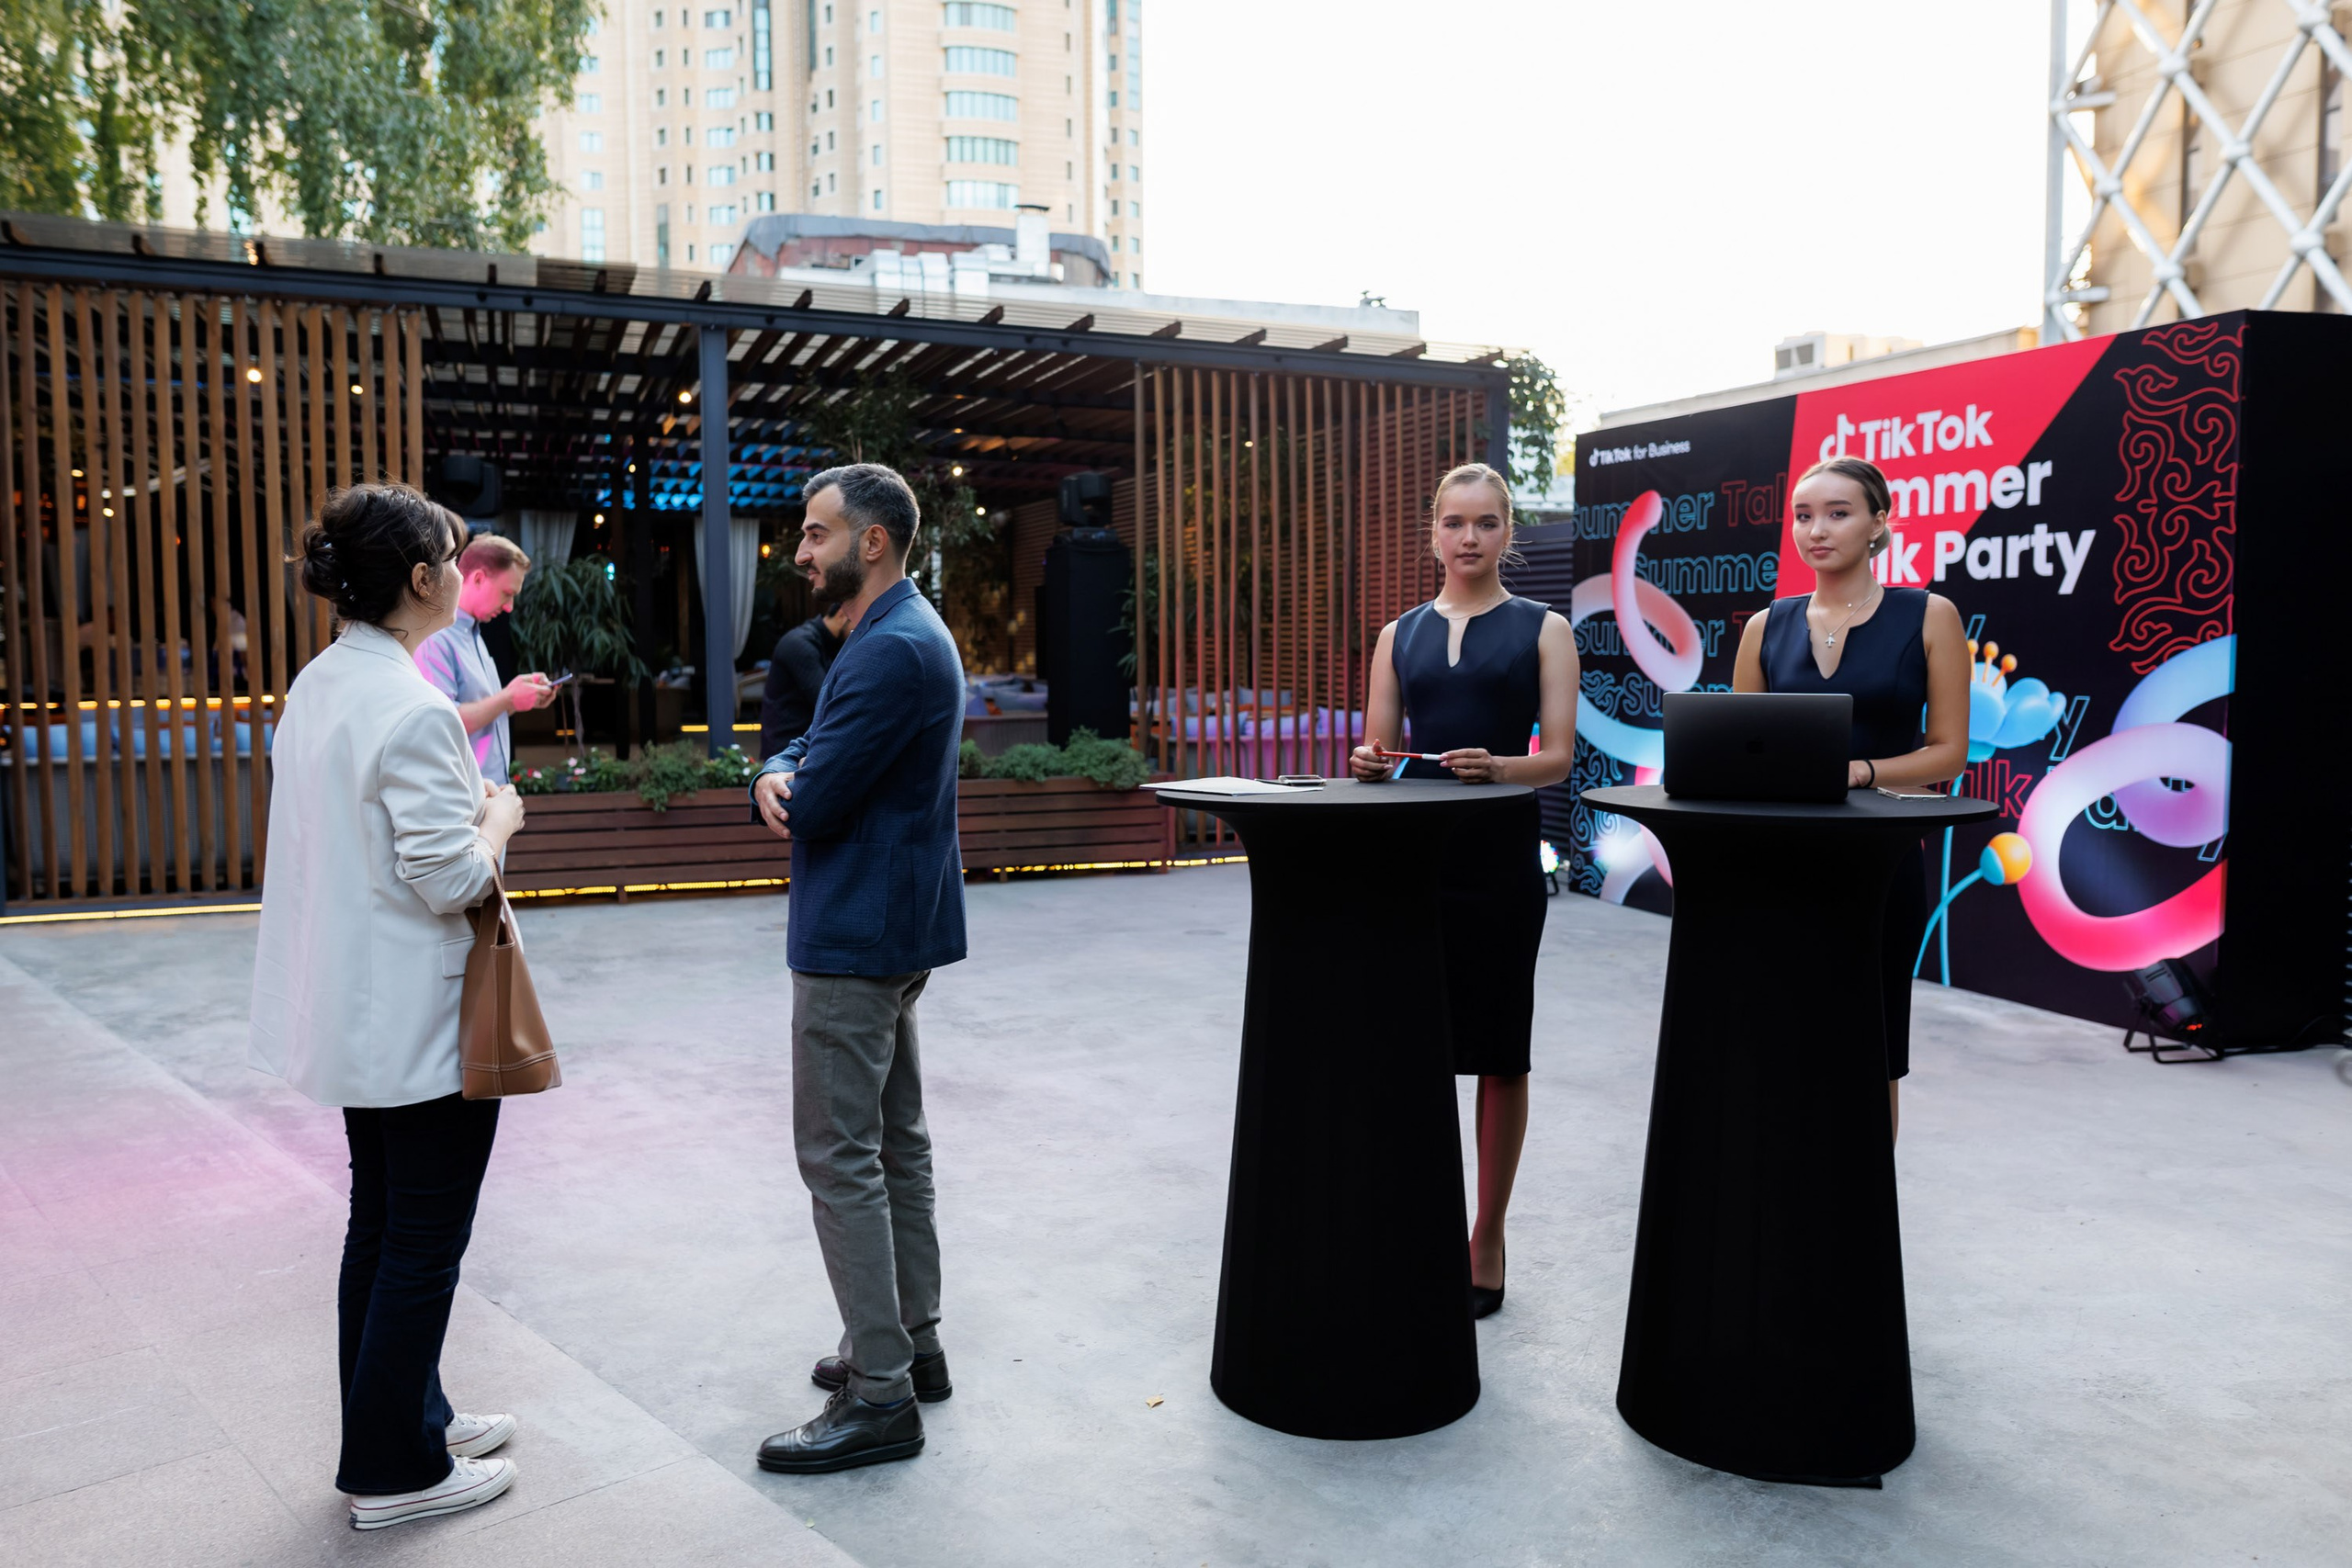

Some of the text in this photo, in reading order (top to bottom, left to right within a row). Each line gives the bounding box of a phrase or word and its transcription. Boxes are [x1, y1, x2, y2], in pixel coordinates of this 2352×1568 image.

[1600, 440, 1691, 465] TikTok for Business
[1860, 404, 1994, 461] TikTok
[1886, 460, 2052, 518] mmer
[1933, 524, 2097, 595] Party
